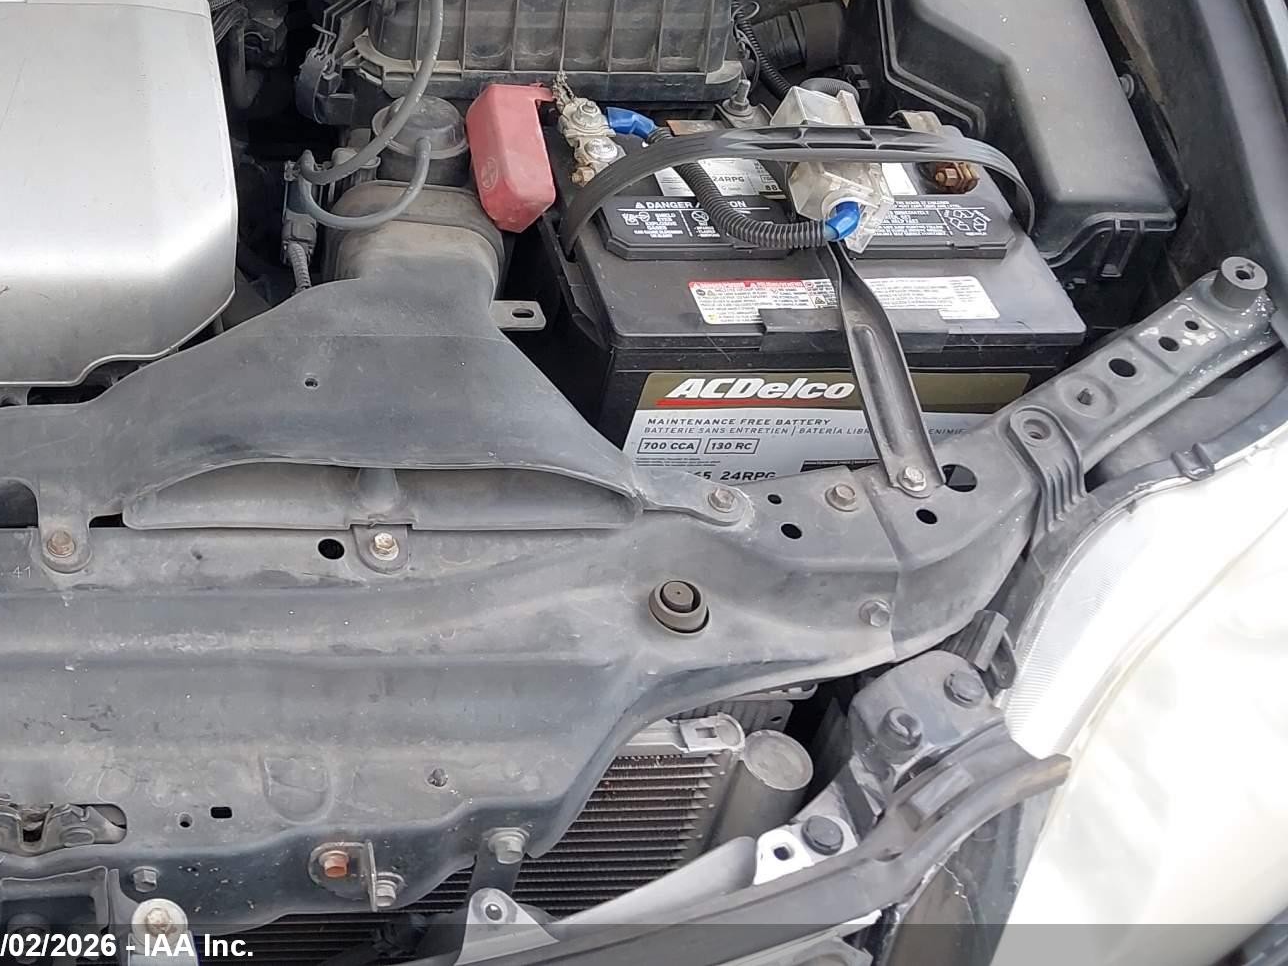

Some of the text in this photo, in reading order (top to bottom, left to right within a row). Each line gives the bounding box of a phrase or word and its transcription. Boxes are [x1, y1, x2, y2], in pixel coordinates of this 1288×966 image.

[665, 377, 855, 399] ACDelco
[647, 418, 831, 426] MAINTENANCE FREE BATTERY
[643, 442, 695, 450] 700 CCA
[711, 442, 753, 450] 130 RC
